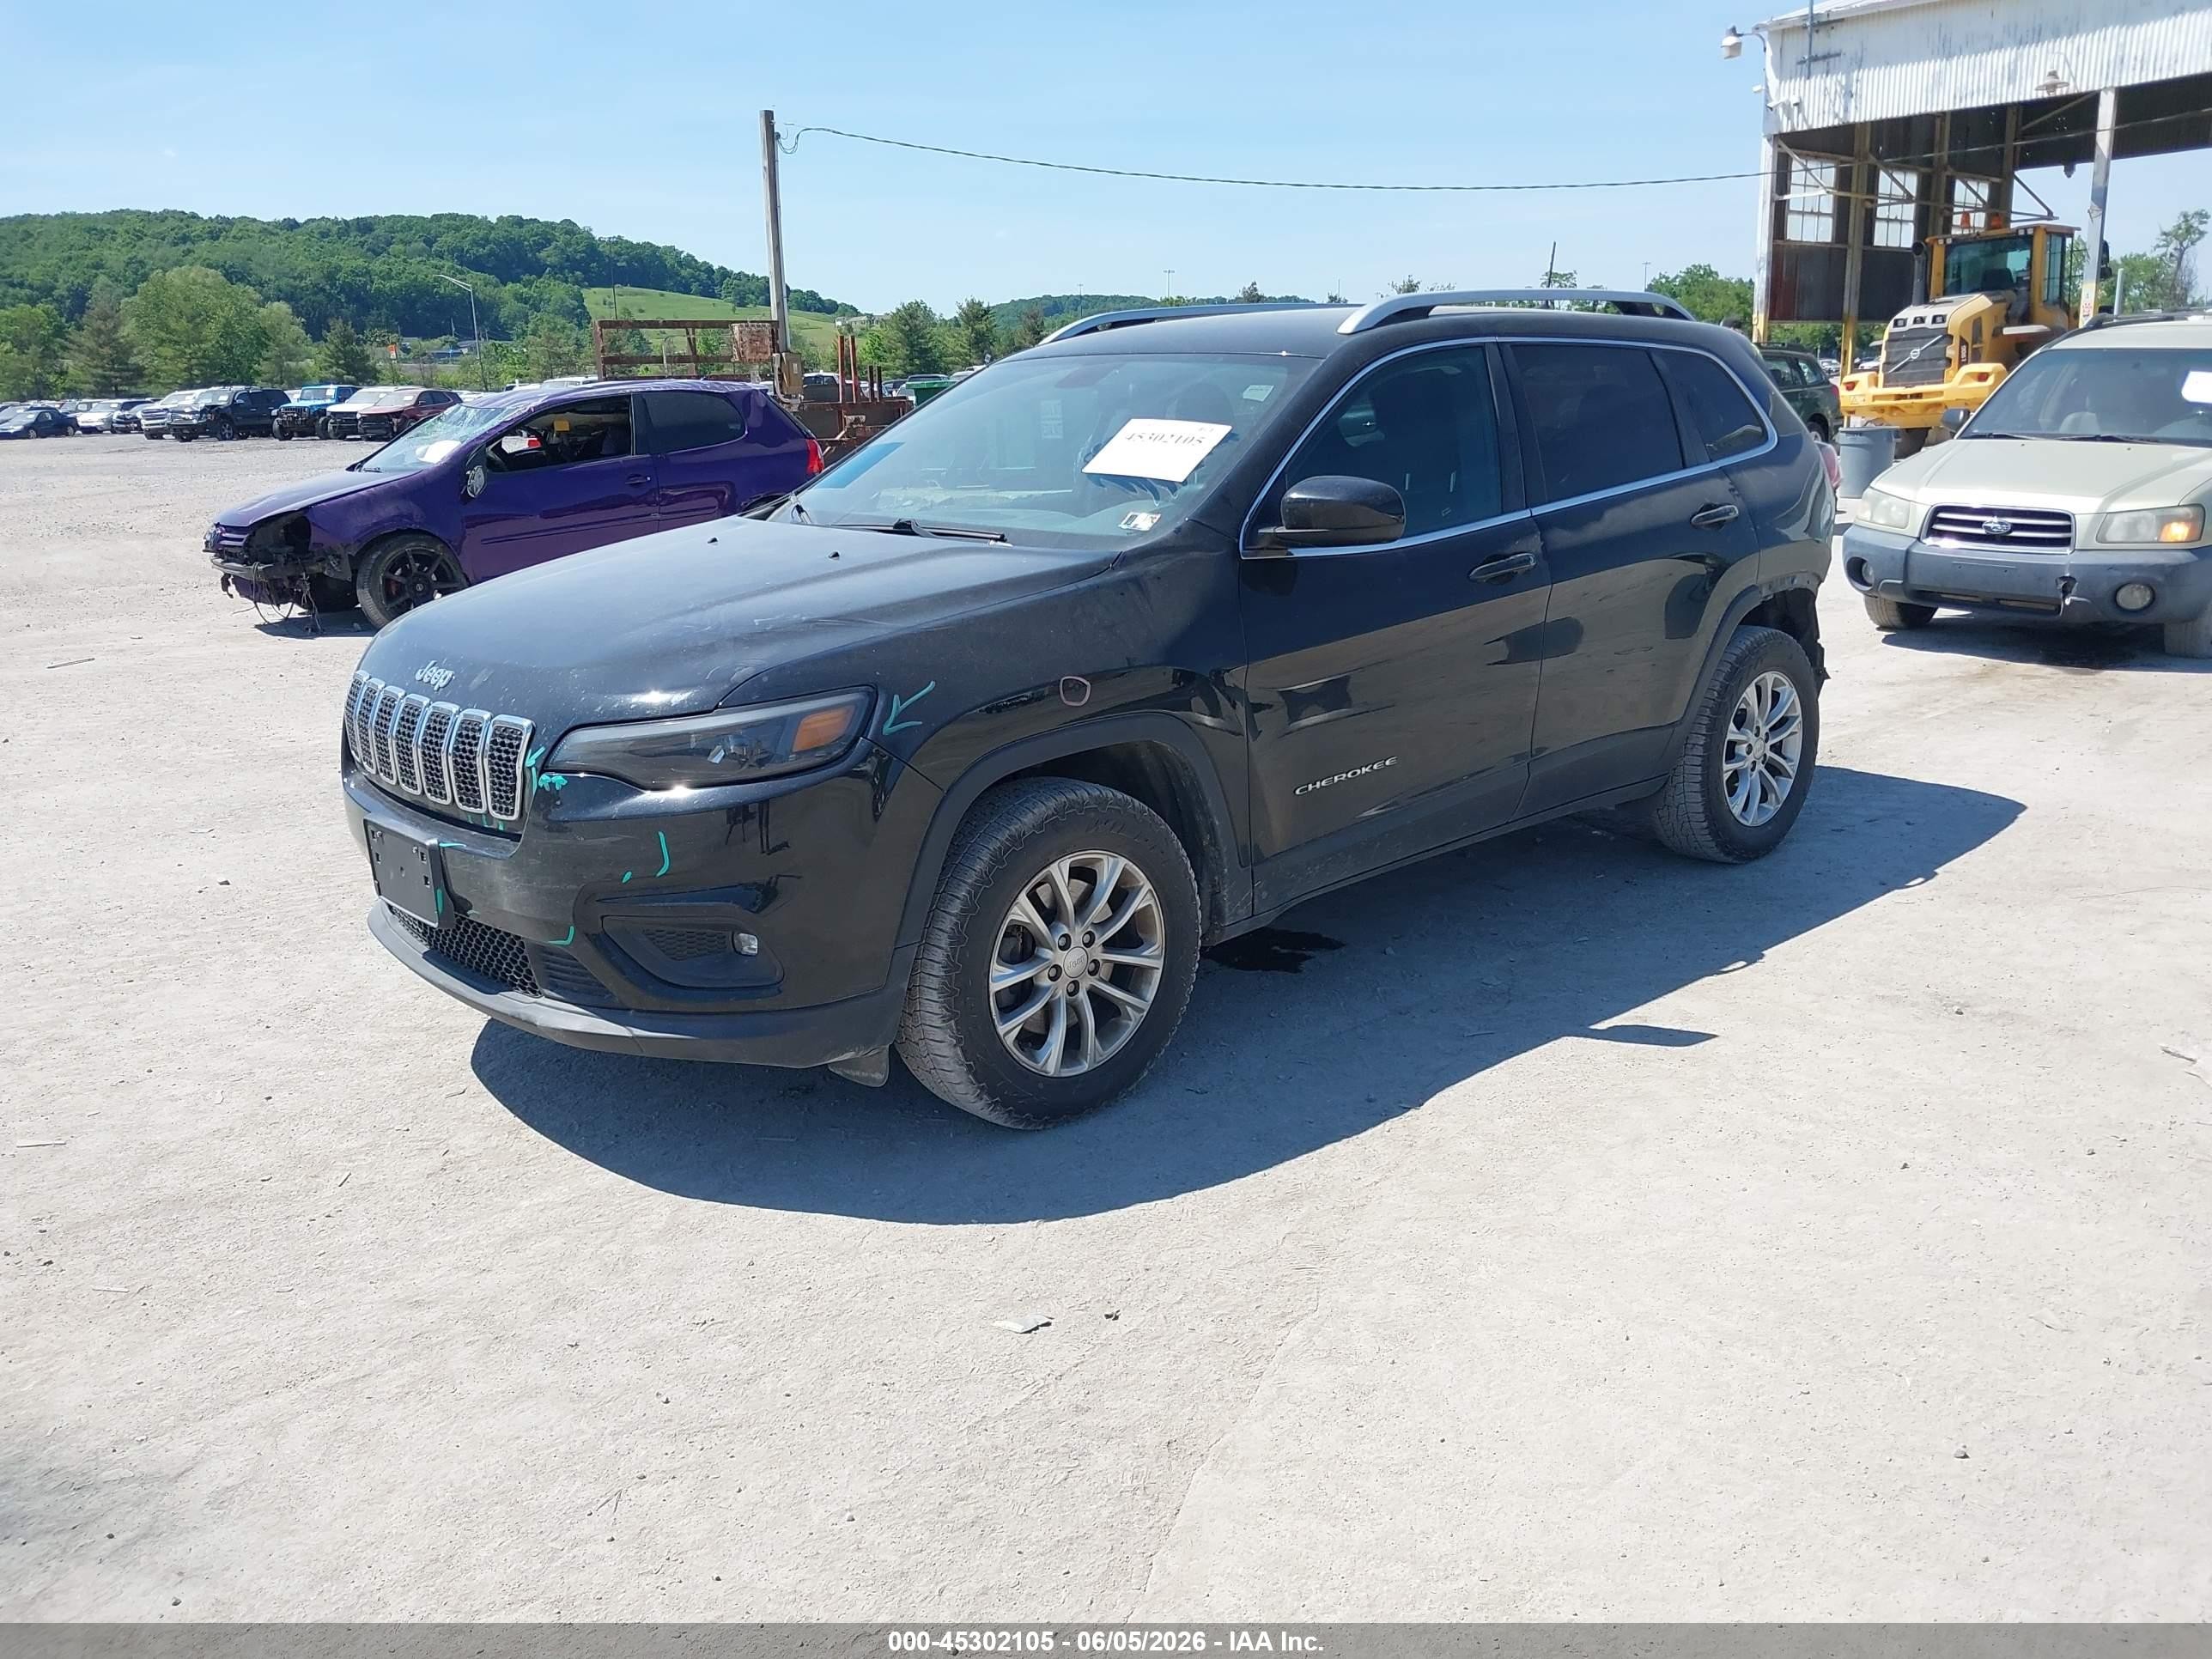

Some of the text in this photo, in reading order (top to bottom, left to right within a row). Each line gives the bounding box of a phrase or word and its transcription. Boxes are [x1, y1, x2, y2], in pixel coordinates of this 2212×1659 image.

[1125, 432, 1204, 447] 45302105
[415, 659, 454, 691] Jeep
[1294, 756, 1398, 795] CHEROKEE
